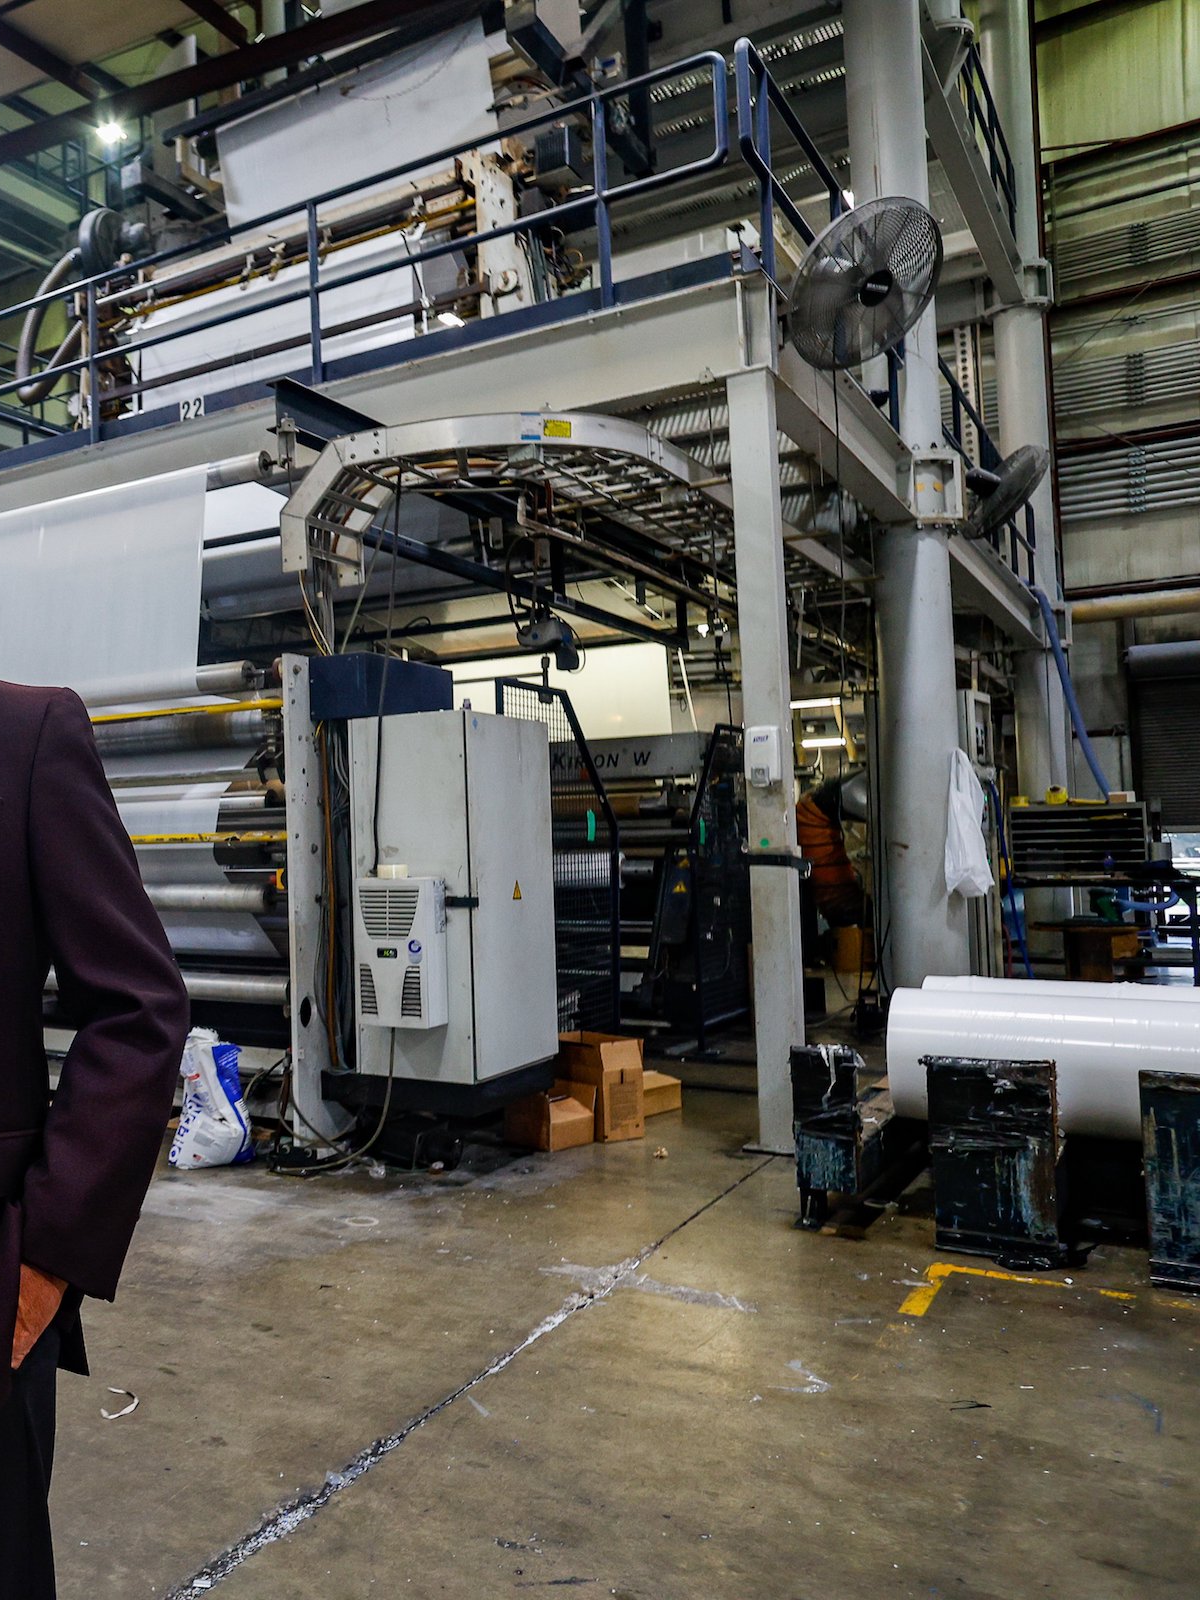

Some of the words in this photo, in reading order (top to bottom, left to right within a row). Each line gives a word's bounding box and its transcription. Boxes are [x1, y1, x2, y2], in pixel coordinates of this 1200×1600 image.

[182, 397, 203, 420] 22
[552, 752, 620, 770] KIRON
[633, 751, 651, 767] W
